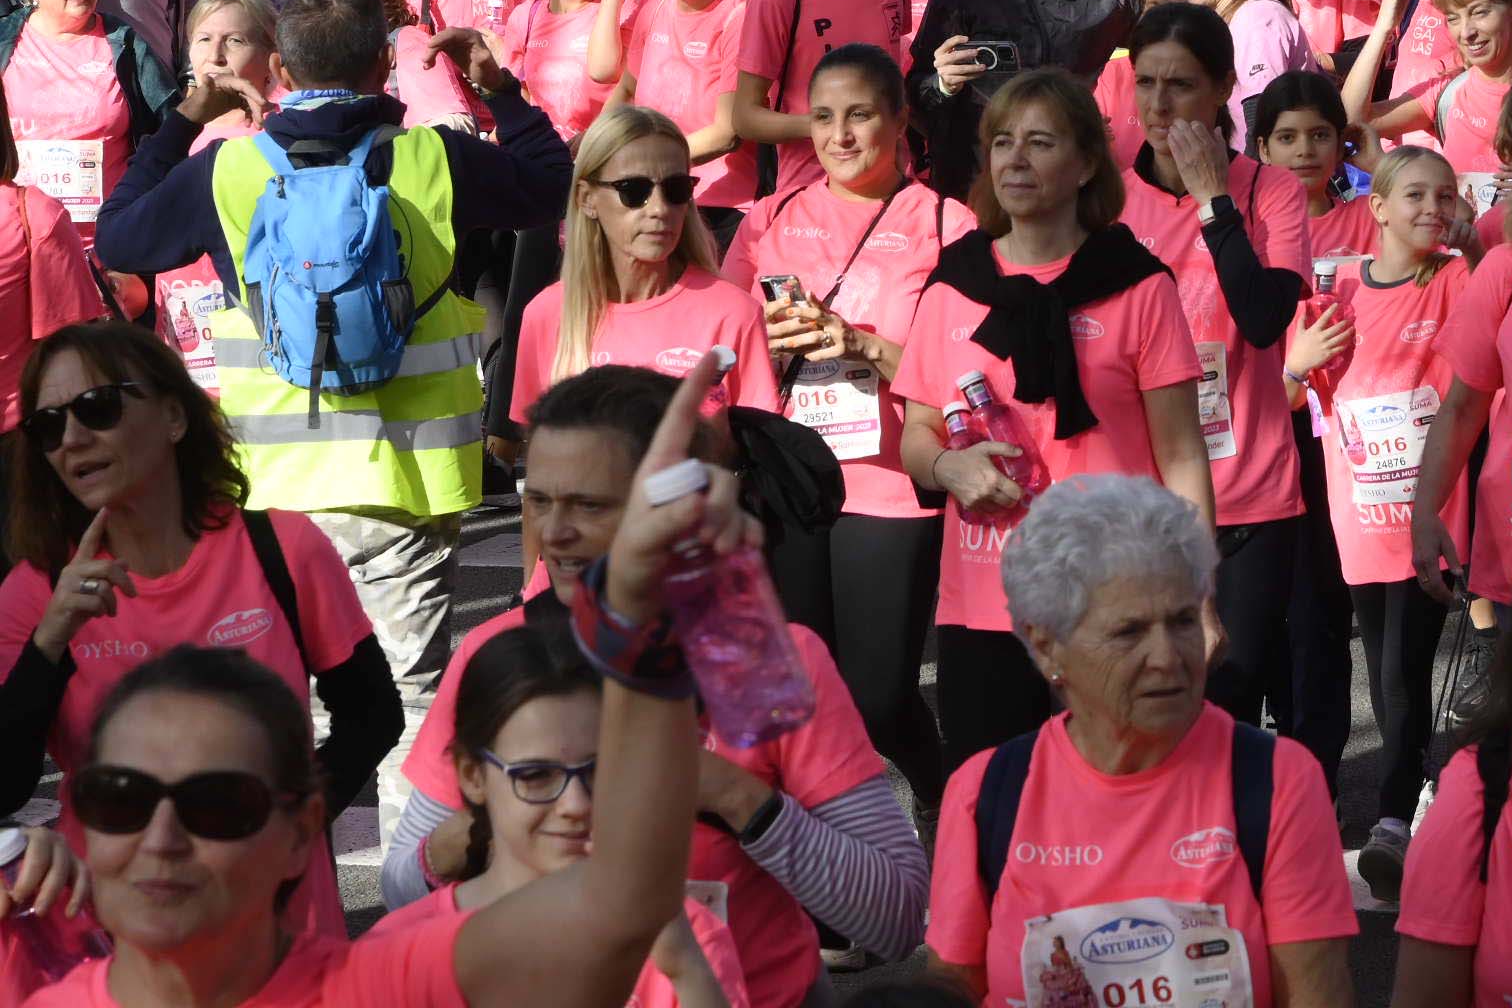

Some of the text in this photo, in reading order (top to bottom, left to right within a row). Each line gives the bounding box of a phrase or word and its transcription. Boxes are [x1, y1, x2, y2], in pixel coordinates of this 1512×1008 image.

[41, 173, 72, 185] 016
[661, 354, 697, 370] ASTURIA
[799, 389, 838, 407] 016
[1369, 436, 1408, 457] 016
[1376, 456, 1406, 470] 24876
[1358, 503, 1412, 525] SUM
[1015, 842, 1103, 866] OYSHO
[1087, 933, 1169, 959] ASTURIANA
[1103, 975, 1174, 1008] 016
